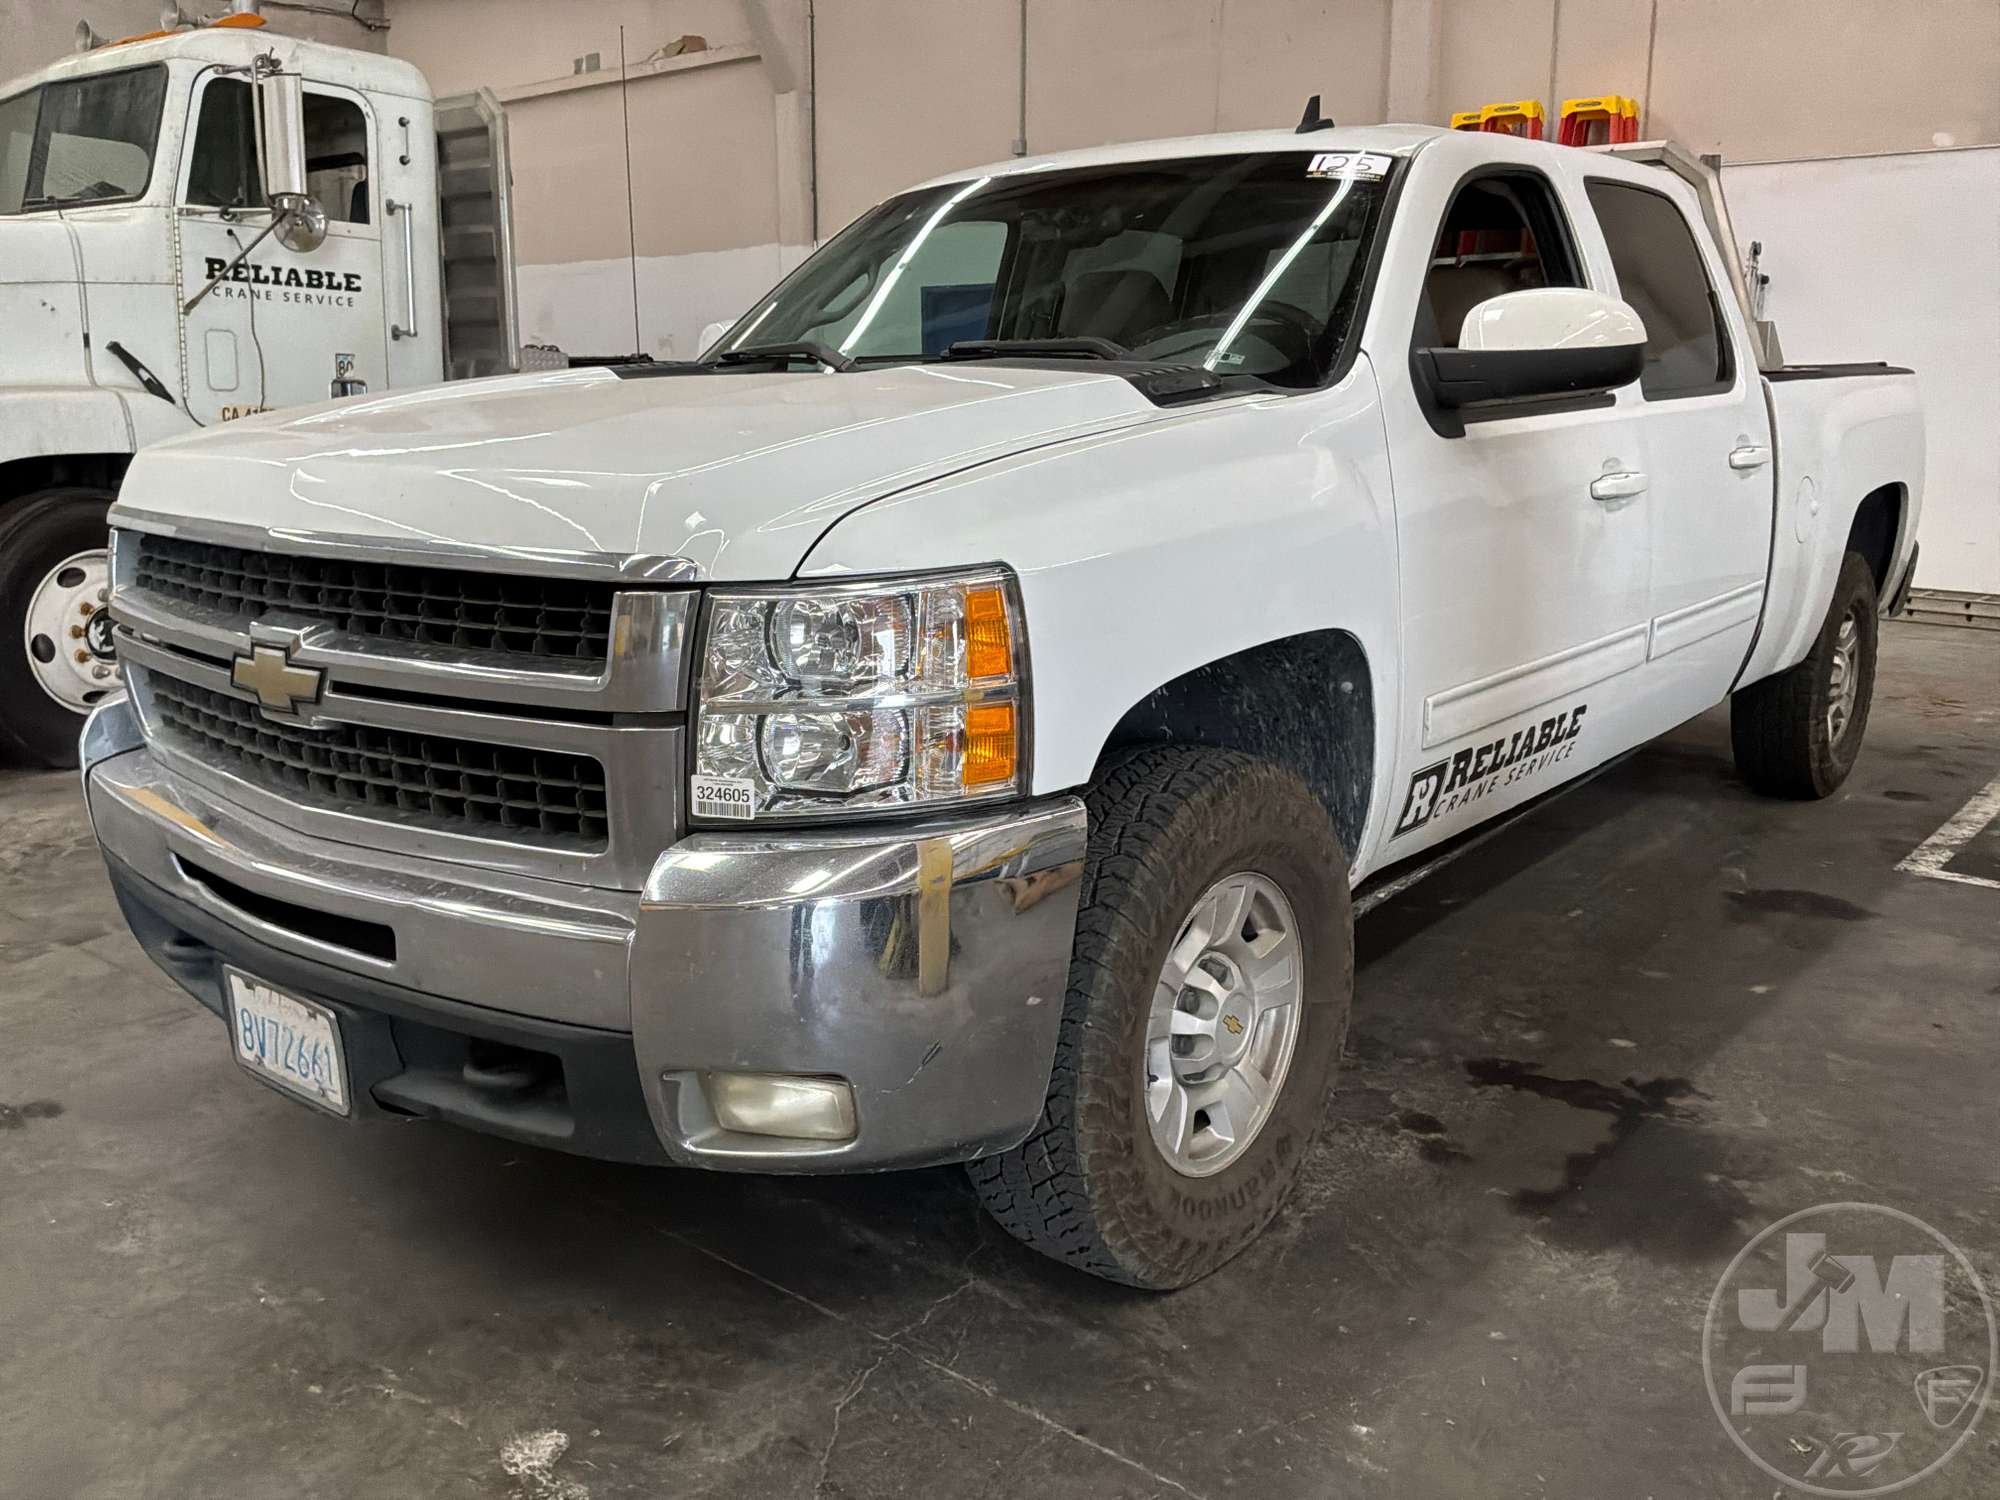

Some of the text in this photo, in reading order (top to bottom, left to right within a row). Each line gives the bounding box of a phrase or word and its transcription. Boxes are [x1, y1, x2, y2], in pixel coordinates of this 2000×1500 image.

[1316, 155, 1375, 172] 125
[205, 257, 362, 292] RELIABLE
[212, 286, 355, 307] CRANE SERVICE
[1443, 704, 1588, 795] RELIABLE
[696, 785, 750, 803] 324605
[1433, 741, 1577, 819] CRANE SERVICE
